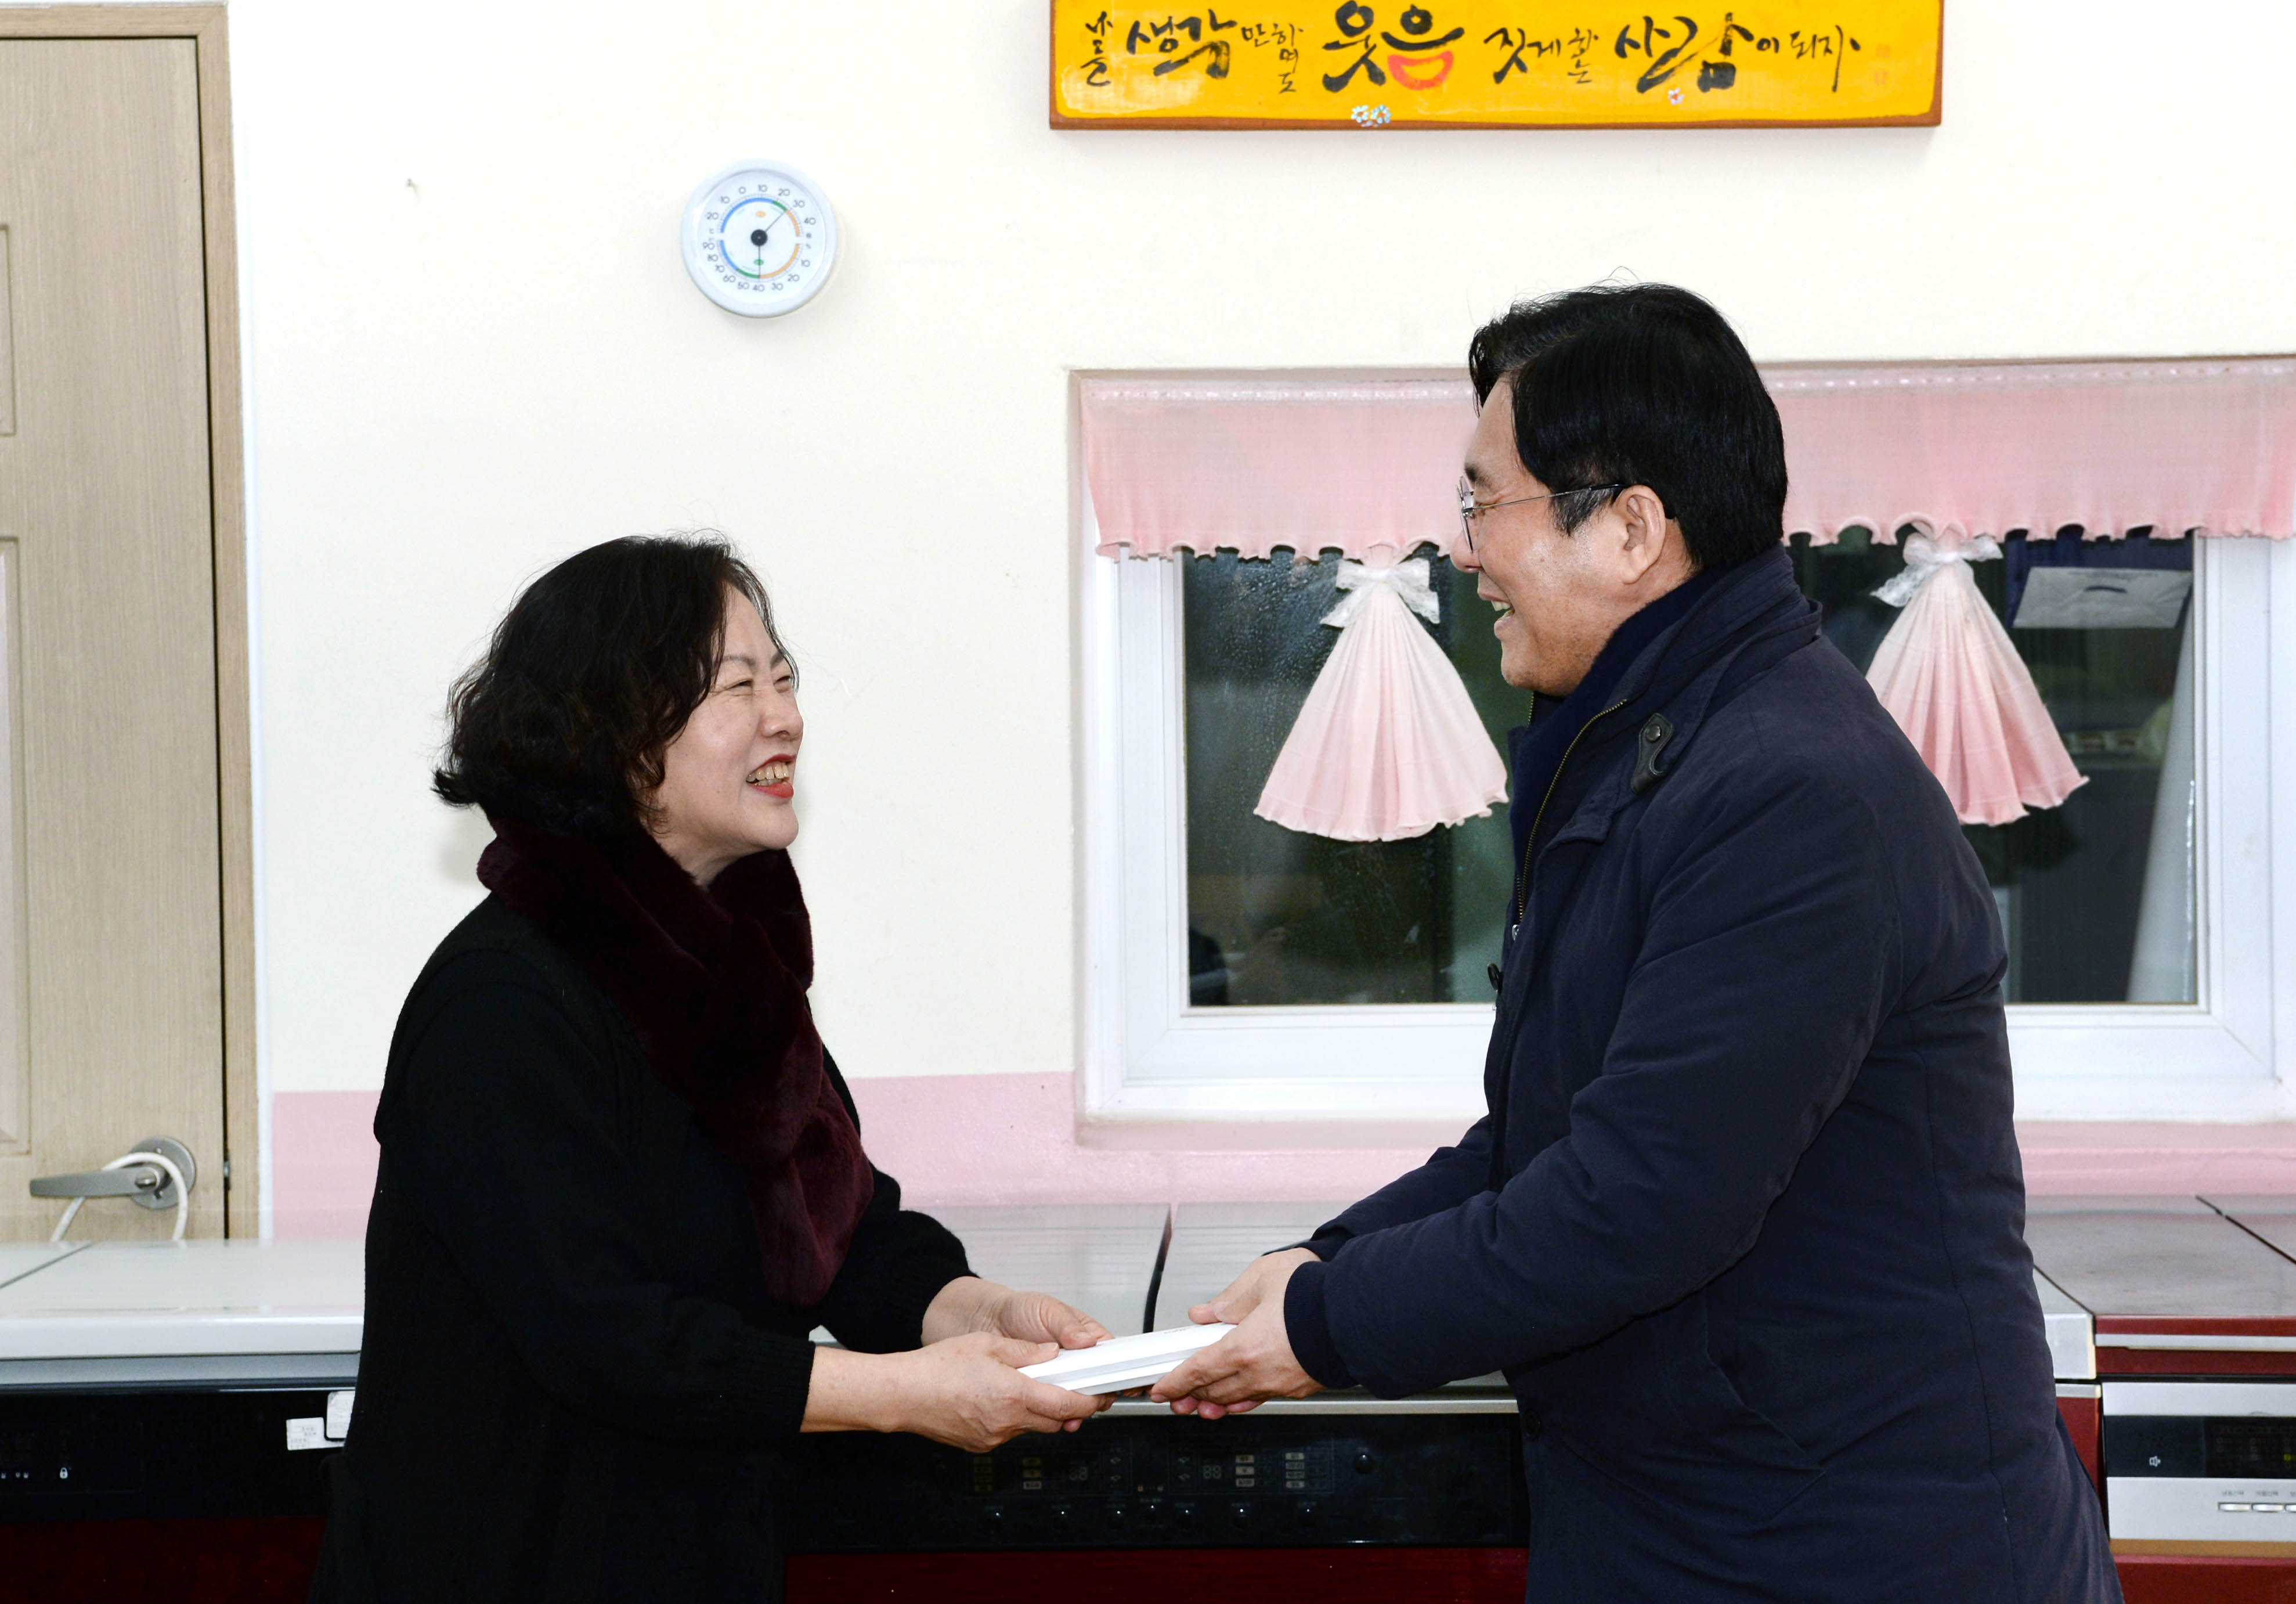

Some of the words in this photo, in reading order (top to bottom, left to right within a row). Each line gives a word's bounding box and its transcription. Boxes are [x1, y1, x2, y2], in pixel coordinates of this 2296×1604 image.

[1322, 0, 1465, 93] 웃음
[738, 186, 746, 194] 0
[778, 188, 790, 197] 20
[793, 200, 805, 208] 30
[804, 217, 817, 225] 40
[702, 241, 716, 251] 90
[707, 254, 719, 262] 80
[801, 259, 811, 268] 10
[715, 265, 725, 273] 70
[723, 275, 736, 283] 60
[788, 274, 800, 282] 20
[752, 284, 765, 292] 40
[771, 283, 784, 291] 30
